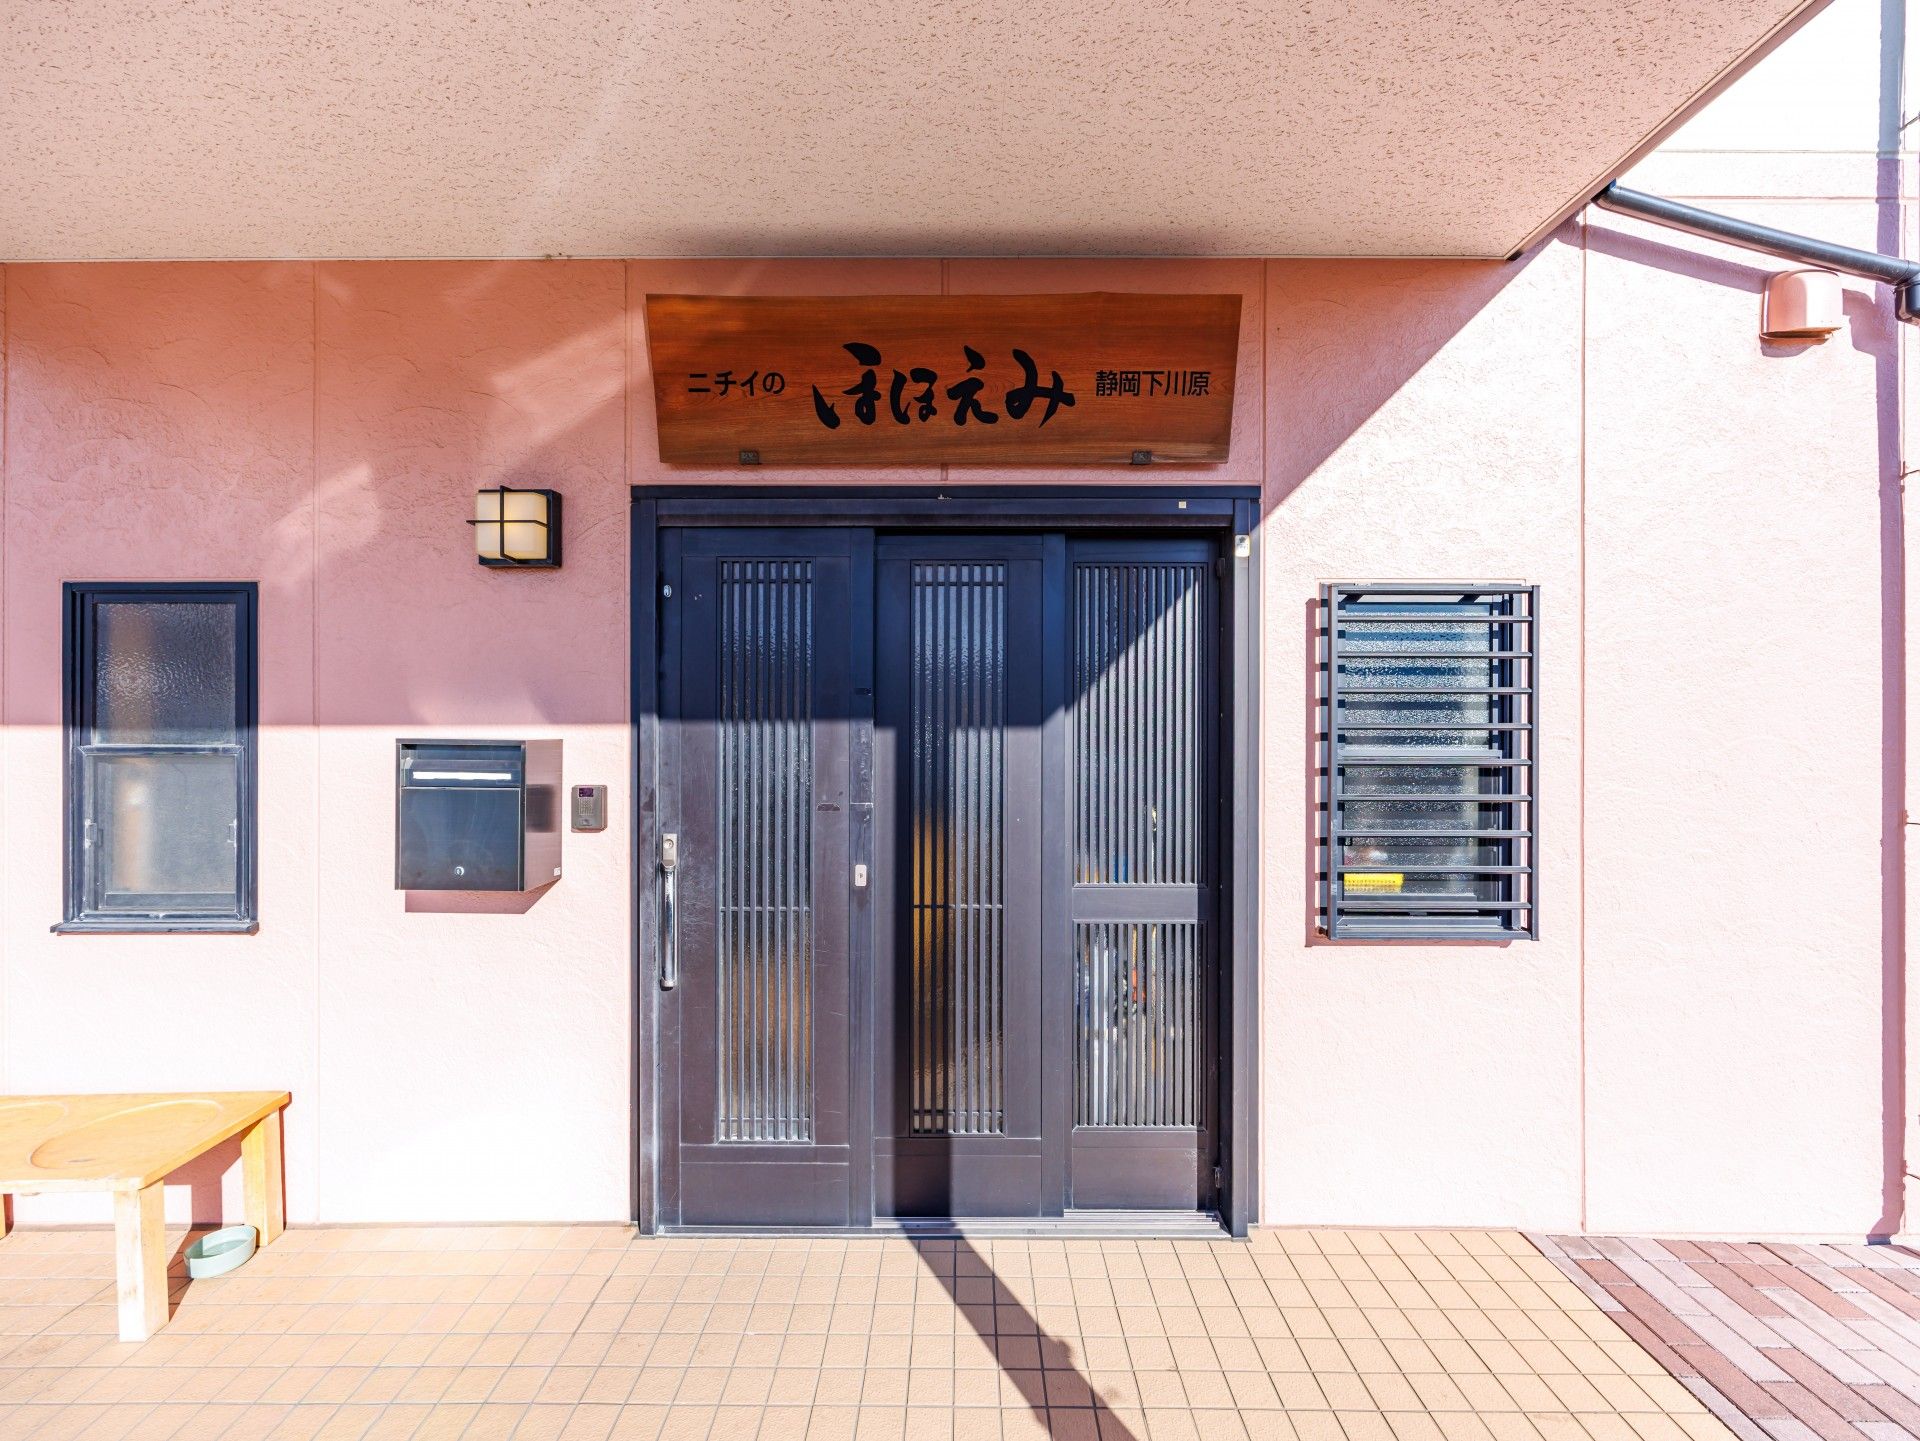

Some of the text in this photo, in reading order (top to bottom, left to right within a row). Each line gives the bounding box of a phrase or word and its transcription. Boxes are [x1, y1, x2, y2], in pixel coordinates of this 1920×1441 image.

[687, 342, 1211, 429] ニチイの ほほえみ 静岡下川原
